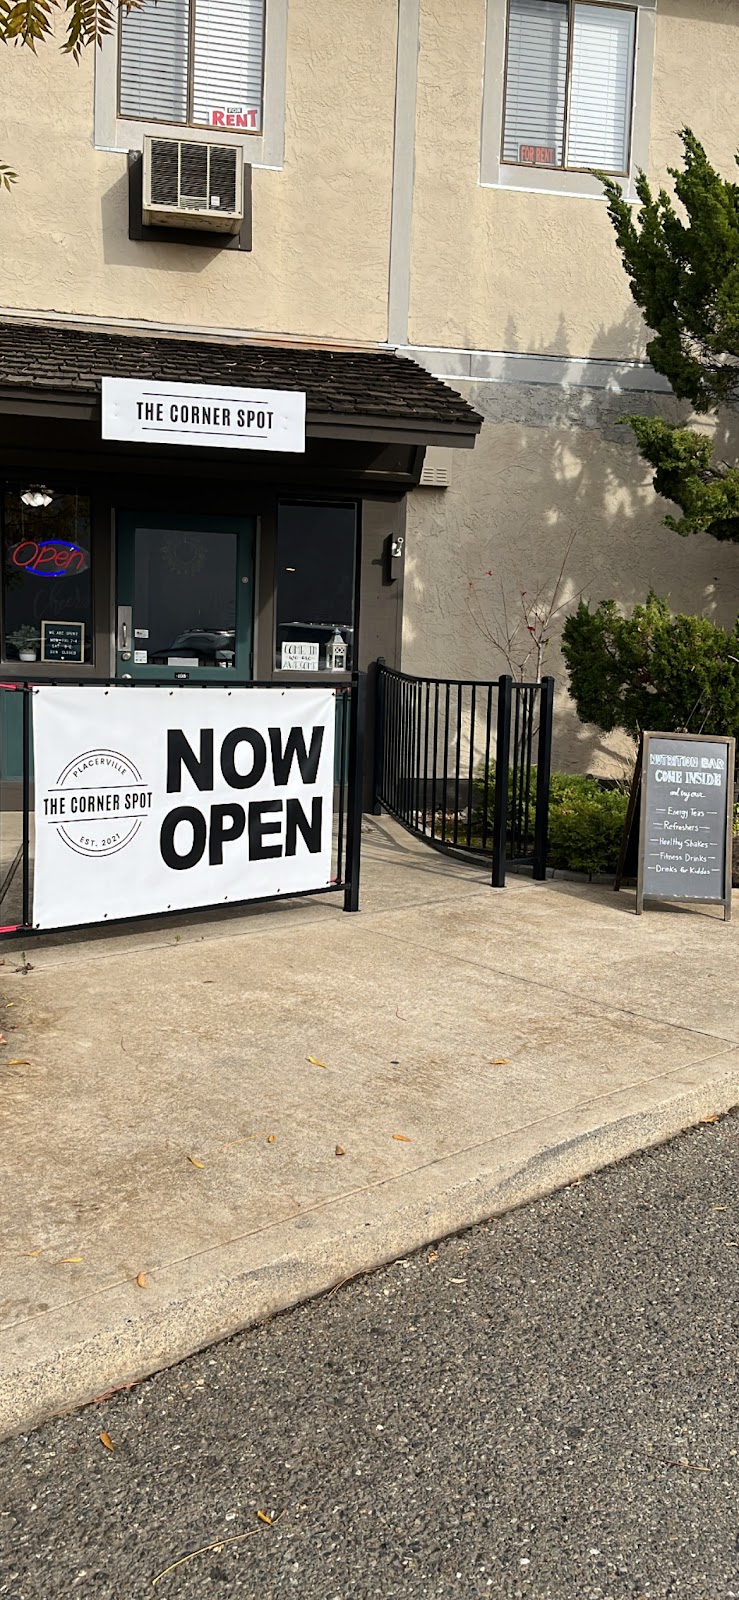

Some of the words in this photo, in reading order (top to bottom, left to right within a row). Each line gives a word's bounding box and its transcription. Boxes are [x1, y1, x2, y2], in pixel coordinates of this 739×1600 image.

[212, 109, 258, 128] RENT
[521, 145, 534, 161] FOR
[536, 147, 553, 163] RENT
[136, 401, 164, 421] THE
[169, 404, 231, 427] CORNER
[237, 409, 274, 429] SPOT
[12, 540, 85, 570] Open
[72, 757, 127, 778] PLACERVILLE
[166, 725, 325, 793] NOW
[650, 753, 699, 768] NUTRITION
[701, 757, 725, 770] BAR
[655, 769, 682, 783] COME
[685, 771, 722, 786] INSIDE
[43, 797, 65, 816] THE
[70, 794, 120, 813] CORNER
[124, 792, 153, 809] SPOT
[667, 806, 689, 819] Energy
[690, 807, 705, 817] Teas
[160, 796, 323, 871] OPEN
[663, 820, 699, 832] Refreshers
[79, 836, 98, 847] EST.
[101, 833, 121, 846] 2021
[659, 837, 683, 850] Healthy
[684, 839, 708, 849] Shakes
[660, 851, 683, 861] Fitness
[684, 853, 707, 863] Drinks
[655, 864, 678, 873] Drinks
